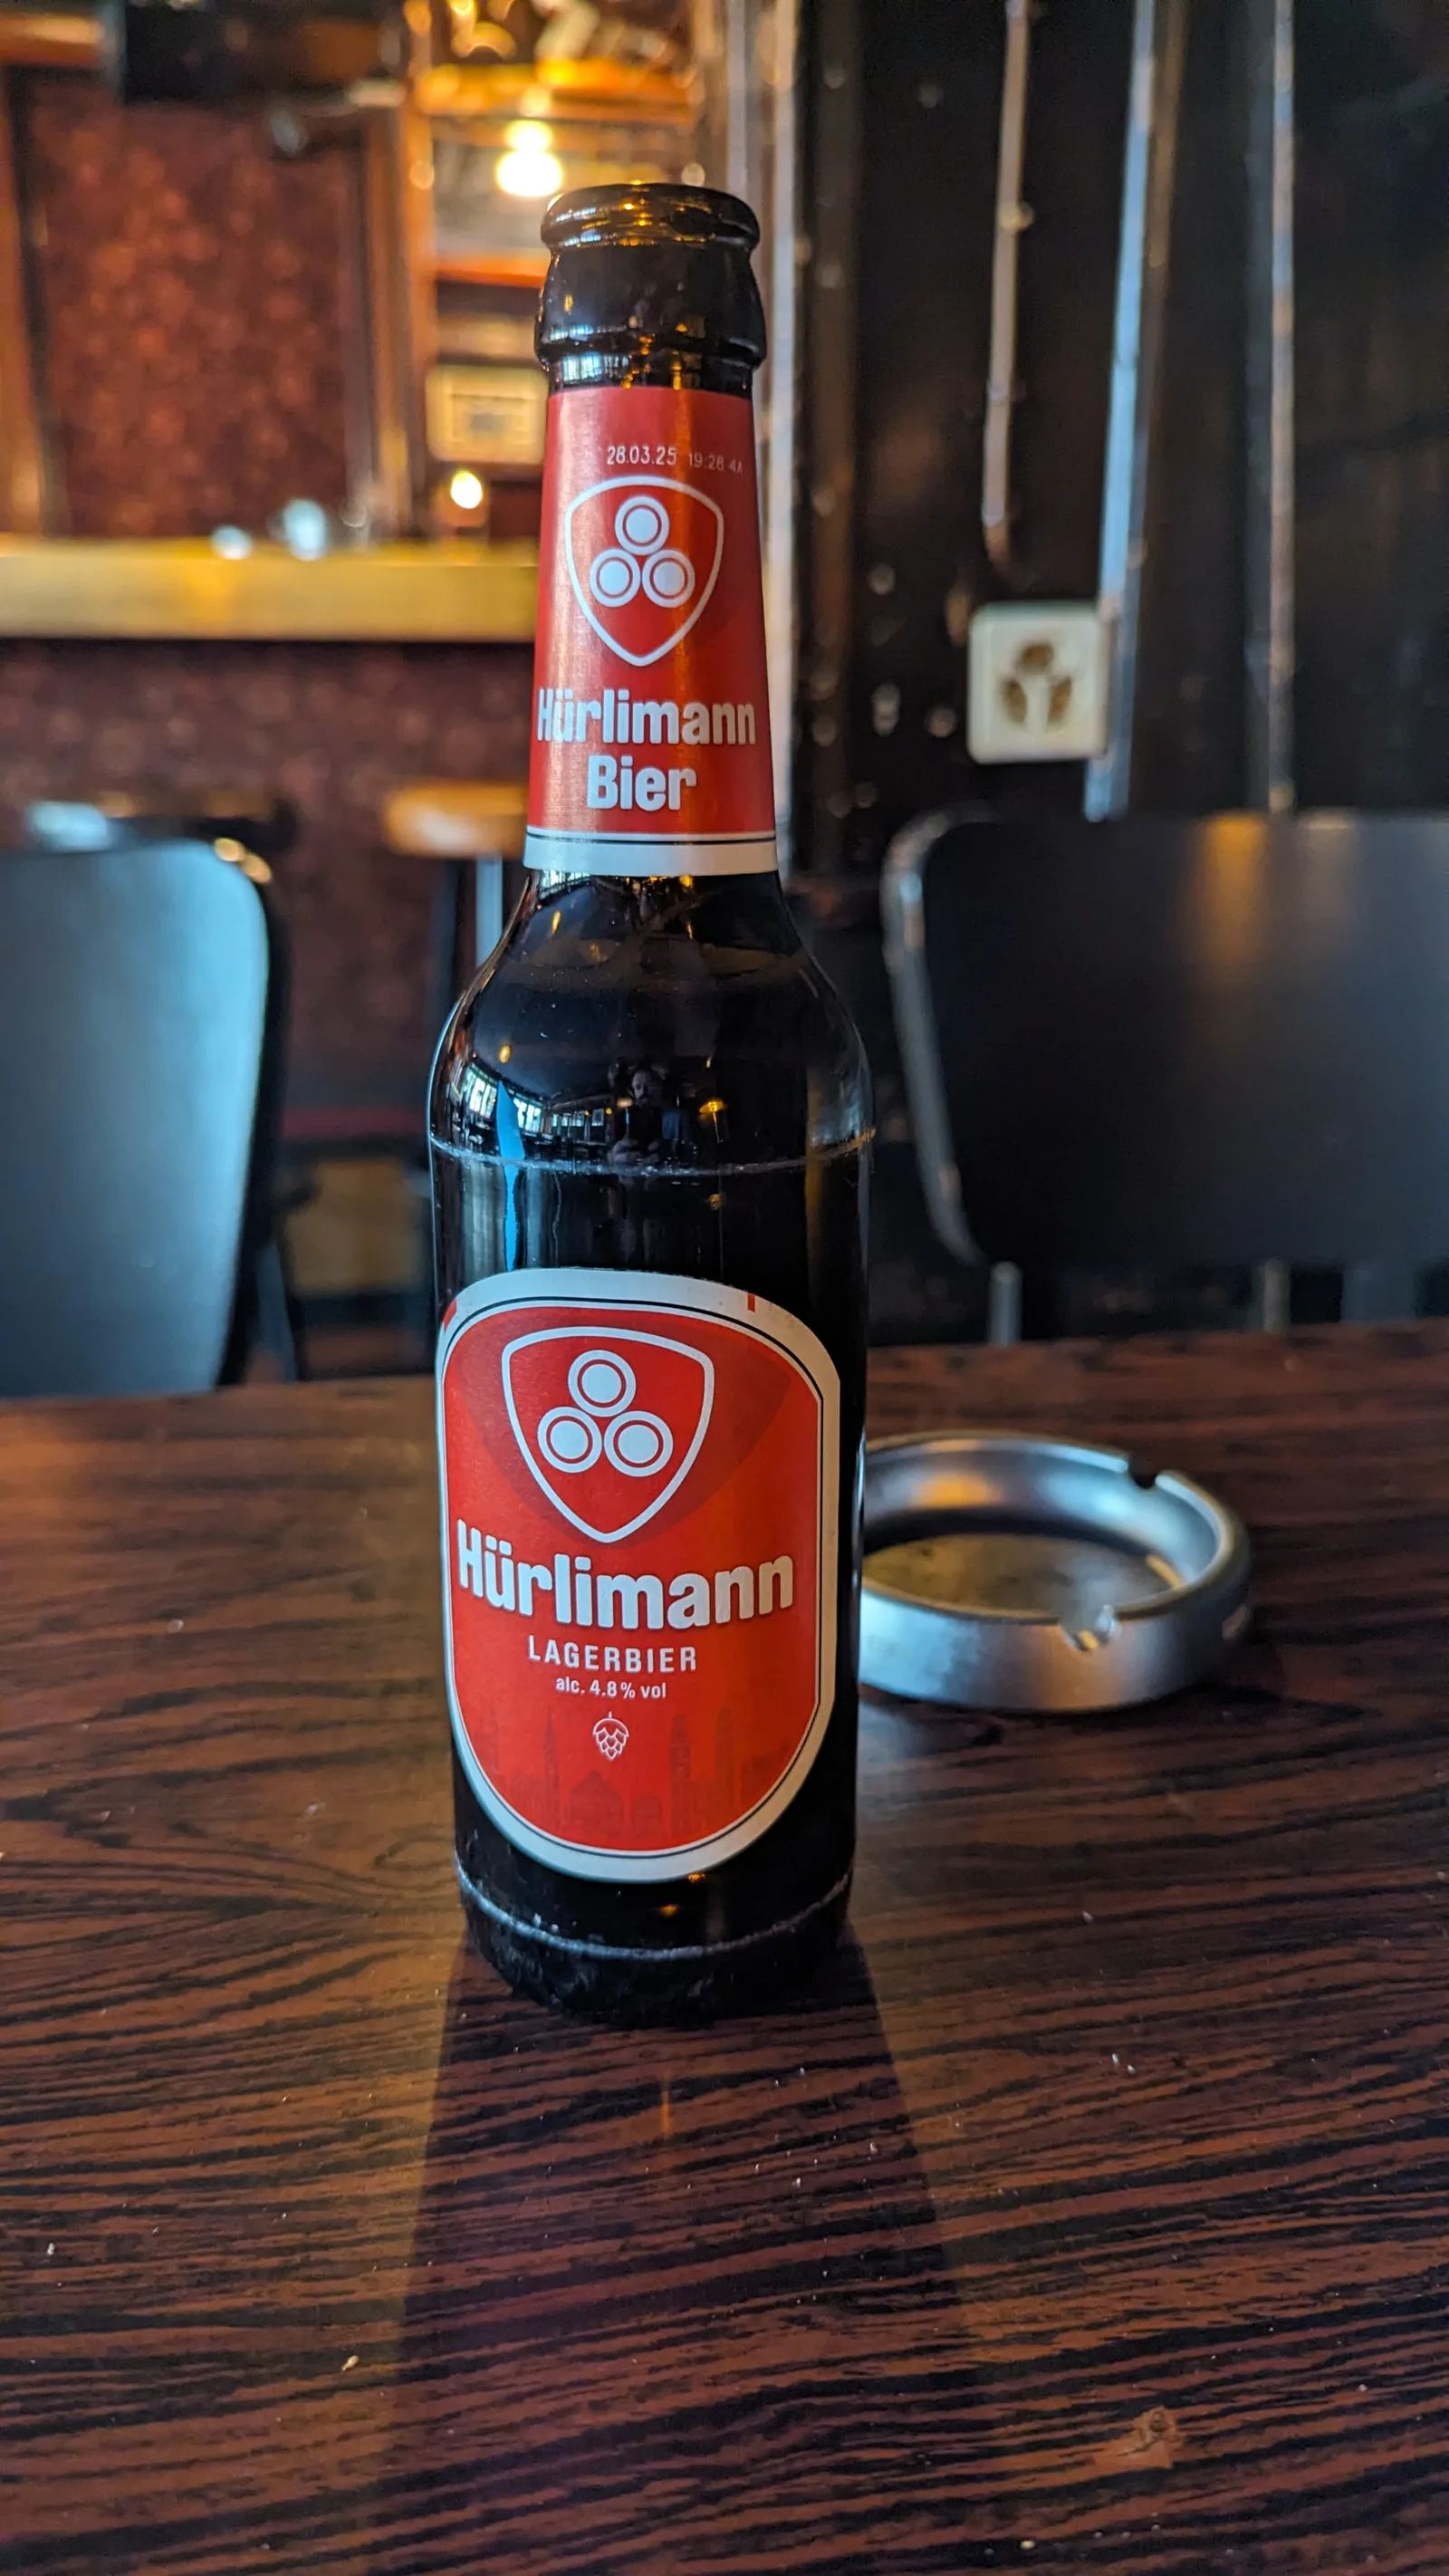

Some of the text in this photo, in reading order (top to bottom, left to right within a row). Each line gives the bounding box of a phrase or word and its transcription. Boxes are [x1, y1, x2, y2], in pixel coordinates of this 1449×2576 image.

[607, 445, 677, 466] 28.03.25
[537, 687, 755, 745] Hürlimann
[587, 755, 696, 812] Bier
[456, 1520, 794, 1630] Hürlimann
[527, 1634, 697, 1673] LAGERBIER
[555, 1676, 586, 1695] alc.
[640, 1682, 667, 1699] vol
